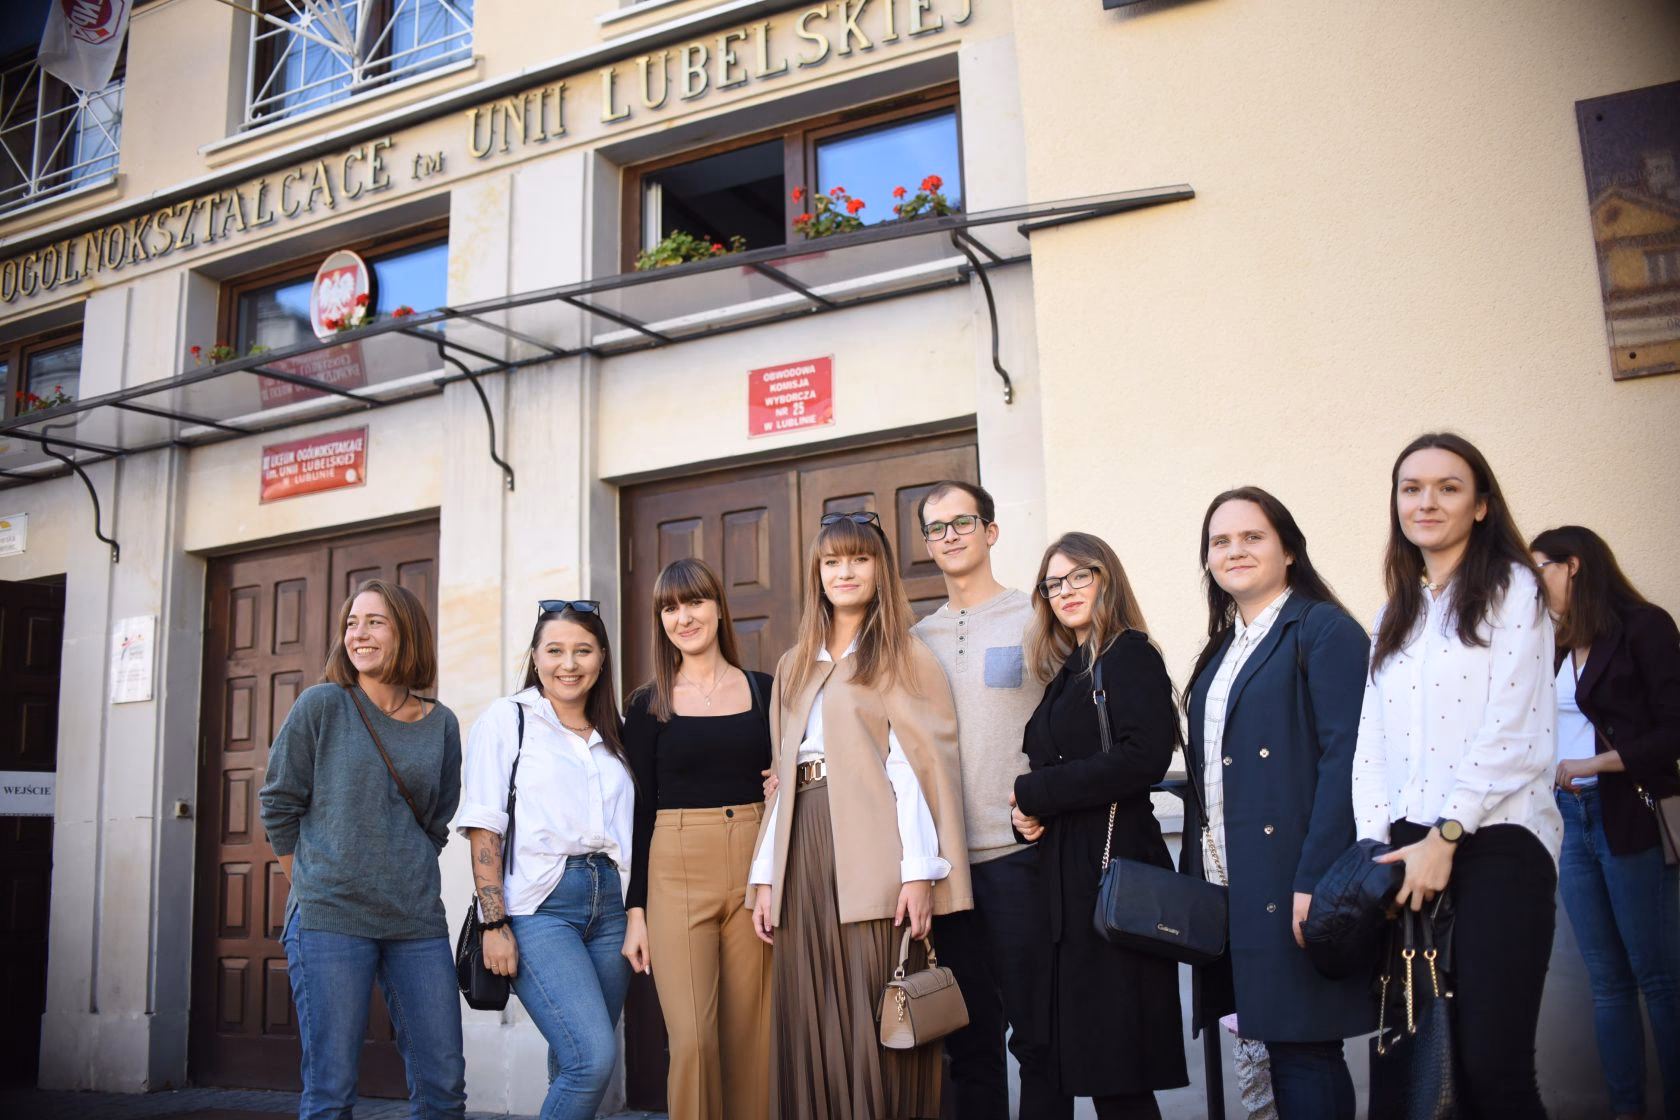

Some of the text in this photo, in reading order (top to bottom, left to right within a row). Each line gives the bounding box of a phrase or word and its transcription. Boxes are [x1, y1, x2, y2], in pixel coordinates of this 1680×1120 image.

[465, 81, 568, 159] UNII
[763, 364, 816, 382] OBWODOWA
[769, 378, 810, 392] KOMISJA
[765, 390, 817, 406] WYBORCZA
[775, 407, 789, 416] NR
[763, 414, 817, 431] W LUBLINIE
[302, 453, 355, 472] LUBELSKIEJ
[3, 784, 52, 796] WEJŚCIE
